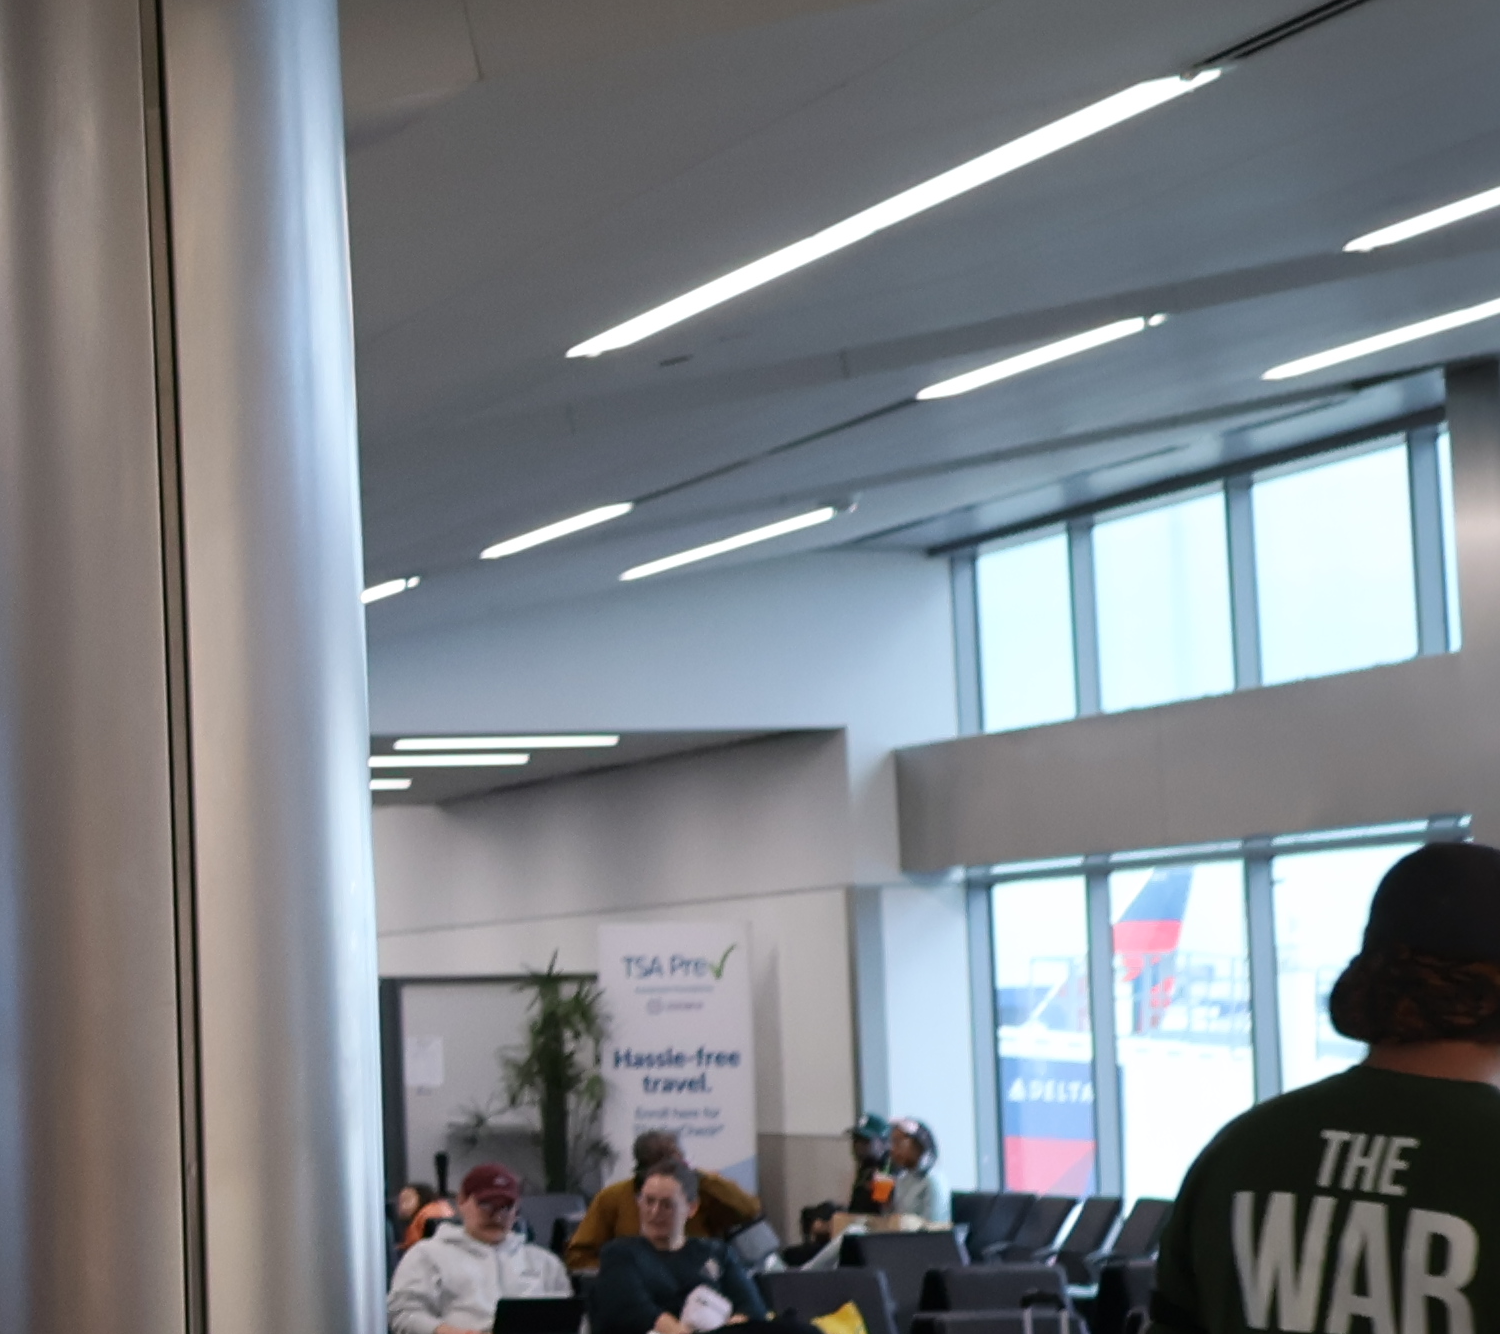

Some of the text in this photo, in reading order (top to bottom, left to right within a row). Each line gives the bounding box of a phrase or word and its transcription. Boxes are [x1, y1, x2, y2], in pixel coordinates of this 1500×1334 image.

[623, 953, 709, 979] TSA Pre
[612, 1045, 741, 1070] Hassle-free
[642, 1072, 713, 1095] travel.
[1315, 1128, 1420, 1196] THE
